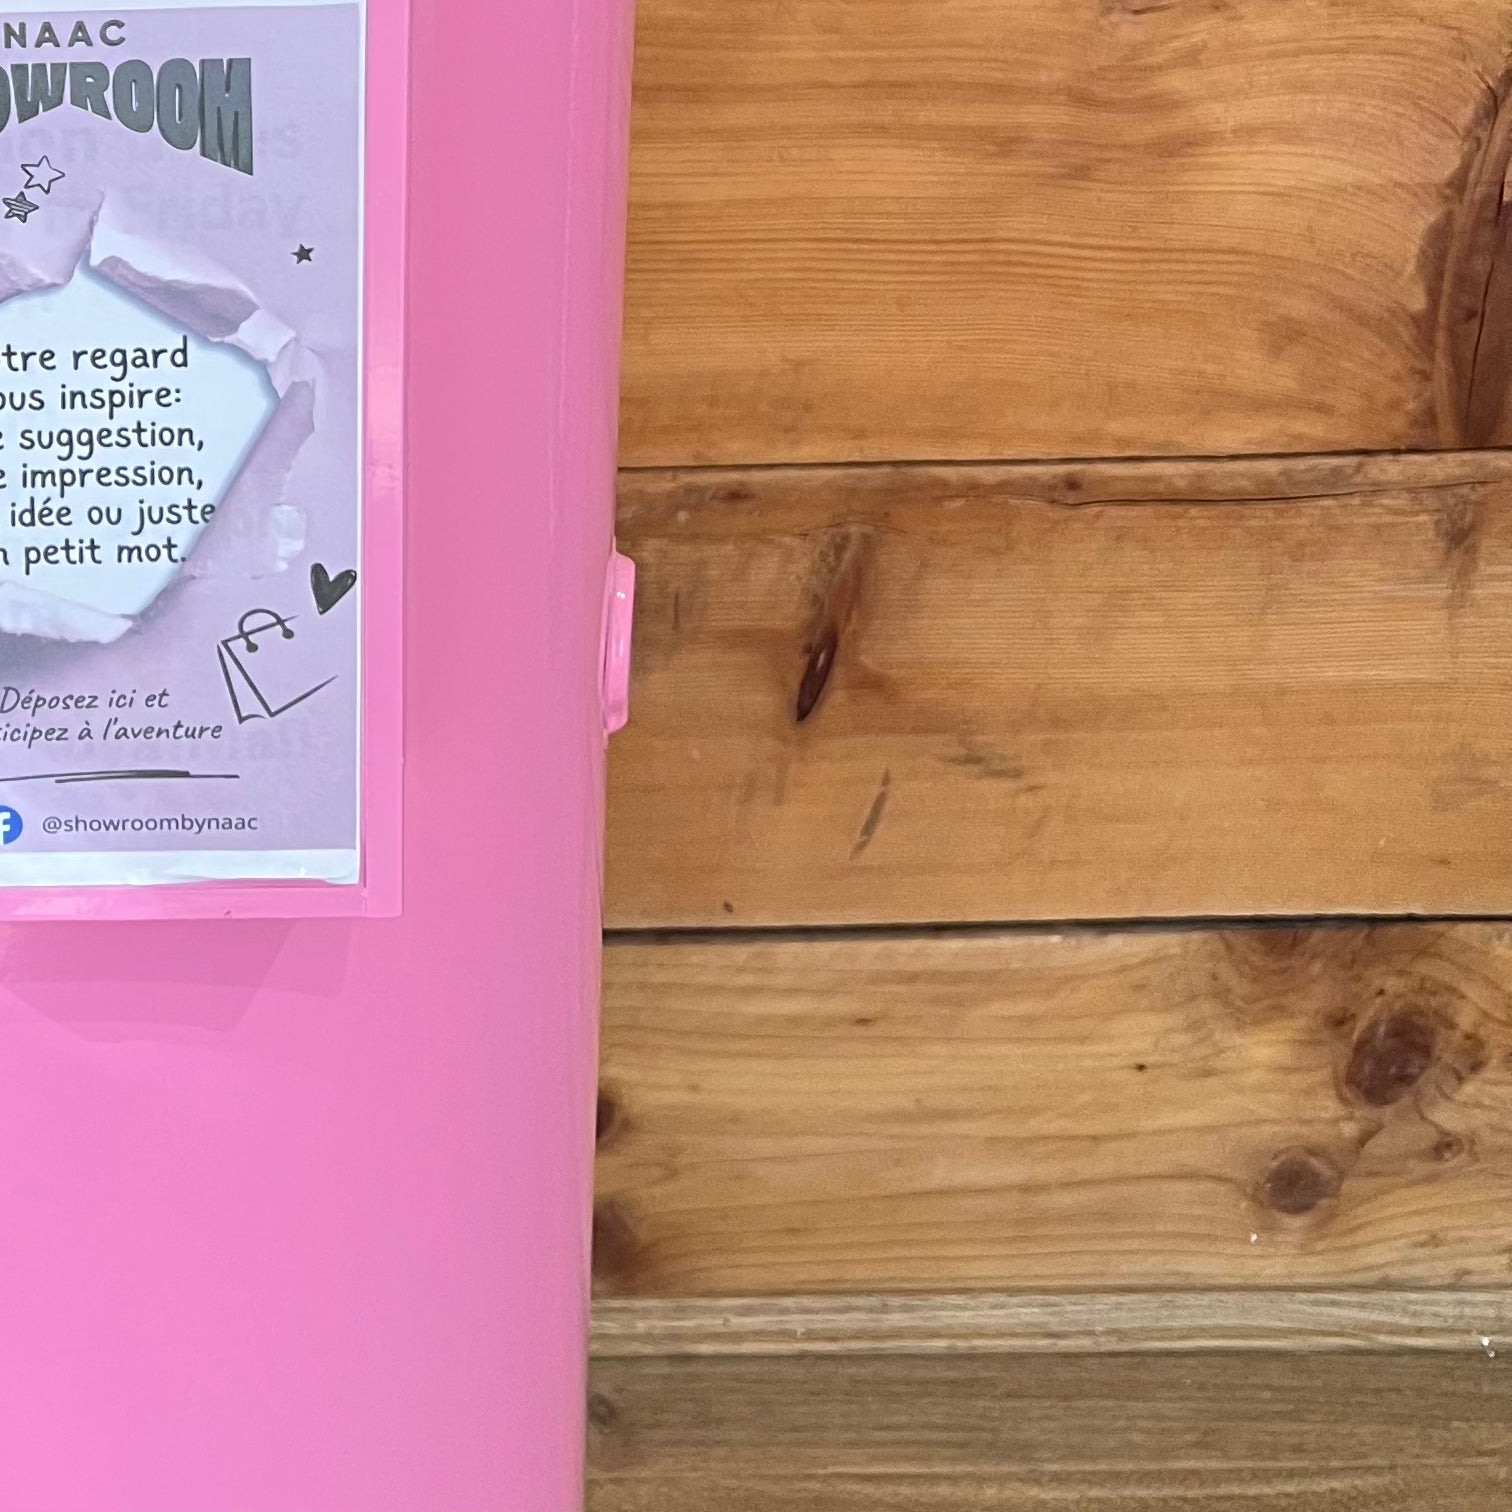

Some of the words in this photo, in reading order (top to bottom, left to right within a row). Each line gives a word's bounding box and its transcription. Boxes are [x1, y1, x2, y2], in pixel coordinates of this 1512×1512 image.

[3, 19, 126, 49] NAAC
[72, 334, 188, 381] regard
[60, 384, 182, 419] inspire:
[19, 421, 204, 461] suggestion,
[22, 461, 203, 497] impression,
[10, 497, 73, 528] idée
[87, 506, 122, 526] ou
[131, 498, 216, 536] juste
[24, 537, 102, 576] petit
[117, 537, 186, 564] mot.
[108, 688, 135, 709] ici
[144, 688, 170, 708] et
[77, 720, 94, 741] à
[102, 717, 223, 741] l'aventure
[42, 813, 258, 835] @showroombynaac
